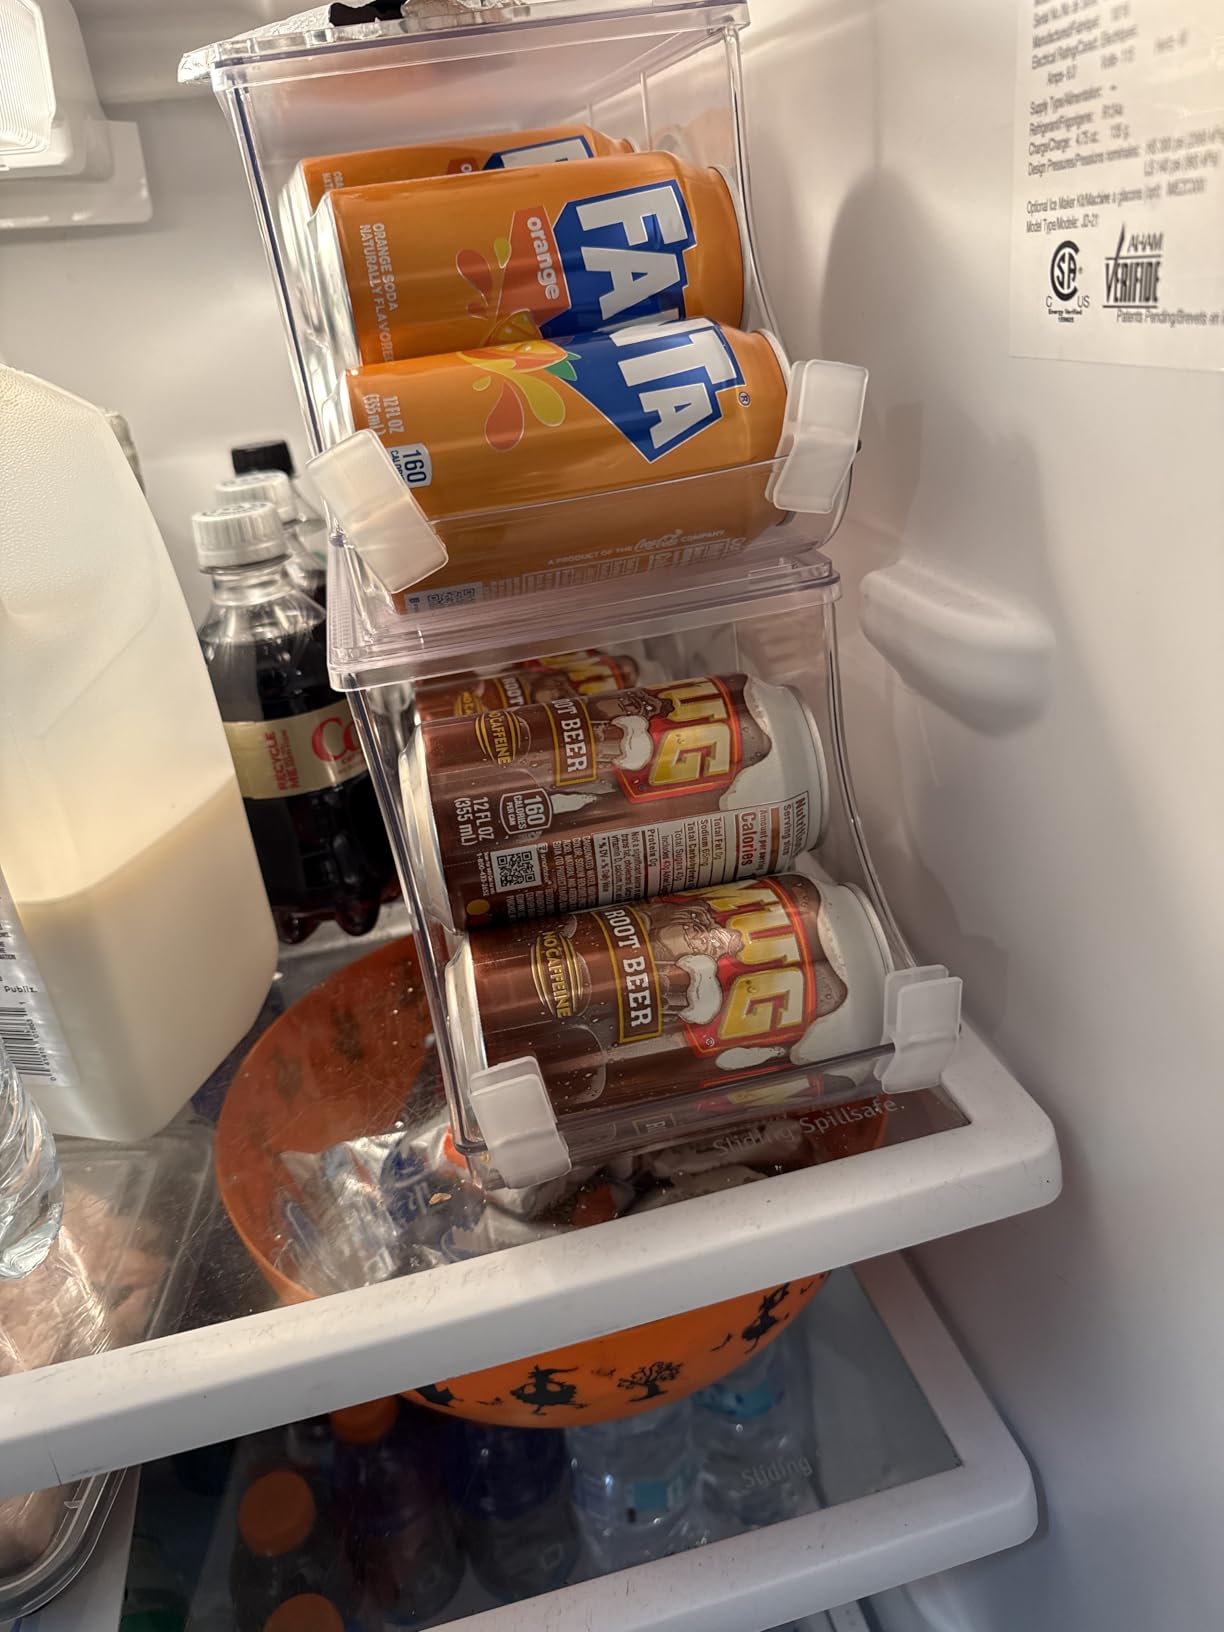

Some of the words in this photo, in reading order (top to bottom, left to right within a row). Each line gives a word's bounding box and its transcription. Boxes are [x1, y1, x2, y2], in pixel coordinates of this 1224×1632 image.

[1026, 199, 1048, 215] Optional
[1059, 196, 1075, 209] Maker
[1026, 220, 1041, 233] Model
[1127, 232, 1164, 253] AHAM
[373, 223, 392, 272] ORANGE
[383, 274, 399, 311] SODA
[527, 216, 560, 300] orange
[360, 224, 382, 294] NATURALLY
[373, 297, 394, 362] FLAVORE
[1077, 295, 1090, 308] US
[388, 419, 404, 433] OZ
[403, 449, 427, 482] 160
[489, 717, 512, 765] CAFFEINE
[561, 716, 588, 772] BEER
[265, 731, 288, 790] RECYCLE
[454, 797, 473, 822] (355
[473, 797, 489, 810] 12
[513, 795, 527, 829] CALORIES
[523, 795, 545, 825] 160
[475, 812, 491, 826] FL
[687, 822, 696, 841] Total
[700, 819, 708, 847] Sodium
[713, 817, 722, 837] Total
[759, 809, 768, 838] Amount
[782, 804, 792, 840] Serving
[459, 822, 478, 846] mL)
[478, 827, 495, 841] OZ
[647, 828, 656, 858] Protein
[661, 835, 670, 860] Includes
[674, 829, 683, 847] Total
[714, 839, 723, 851] Fat
[741, 812, 757, 866] Calories
[674, 849, 684, 871] Sugars
[604, 909, 640, 949] ROOT
[623, 955, 652, 1027] BEER
[545, 948, 572, 1018] CAFFEINE
[799, 1097, 897, 1133] Spillsafe
